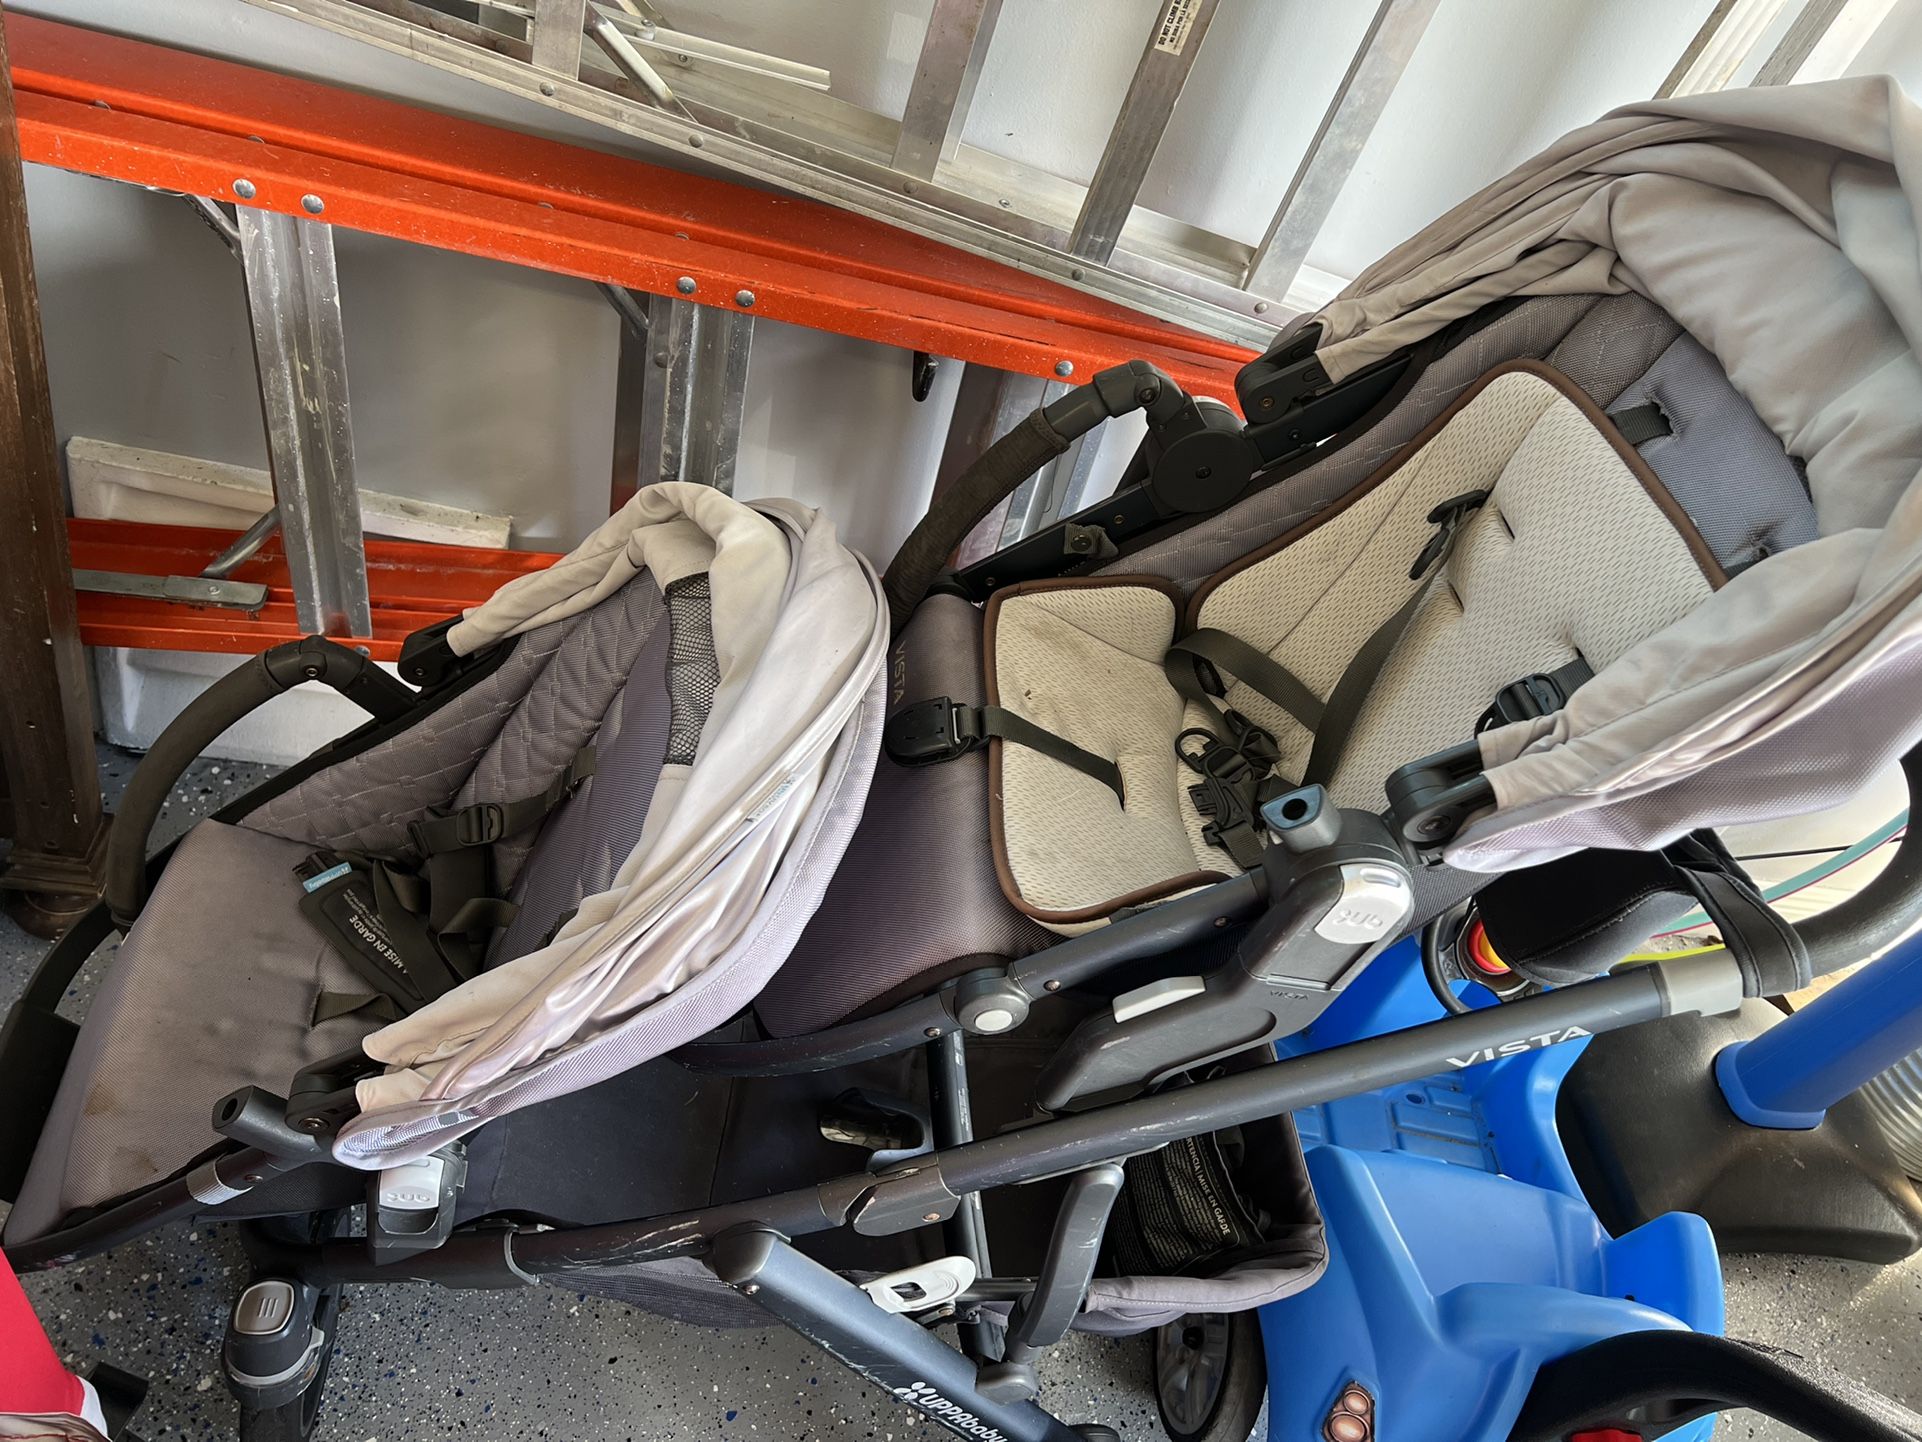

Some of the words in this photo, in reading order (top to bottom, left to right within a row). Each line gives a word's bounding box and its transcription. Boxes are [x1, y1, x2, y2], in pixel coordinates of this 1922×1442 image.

[1158, 36, 1166, 45] DO
[1162, 24, 1171, 36] NOT
[1167, 5, 1179, 24] CLIMB
[894, 639, 906, 705] VISTA
[348, 914, 377, 942] GARDE
[373, 939, 388, 952] EN
[384, 947, 405, 969] MISE
[1445, 1025, 1592, 1068] VISTA
[1196, 1174, 1211, 1194] MISE
[1207, 1193, 1219, 1208] EN
[1213, 1207, 1231, 1235] GARDE
